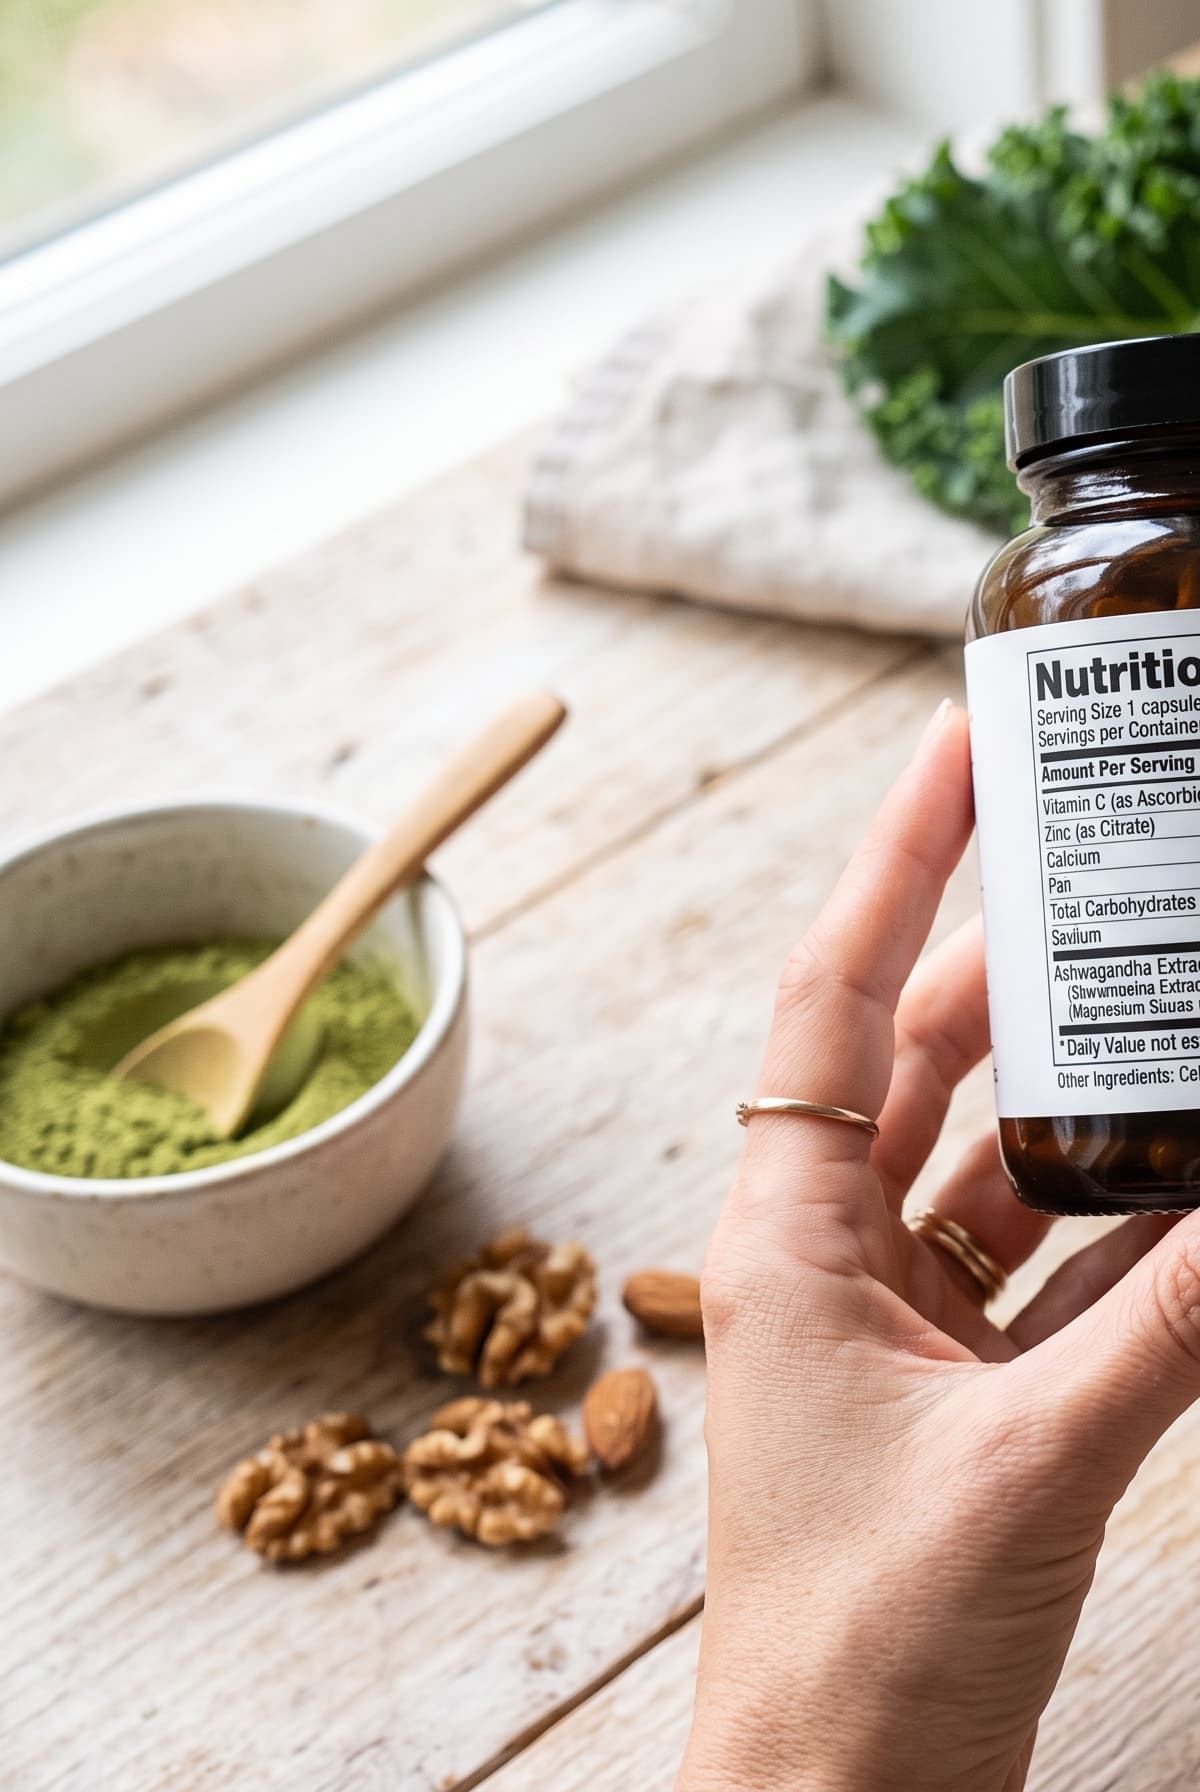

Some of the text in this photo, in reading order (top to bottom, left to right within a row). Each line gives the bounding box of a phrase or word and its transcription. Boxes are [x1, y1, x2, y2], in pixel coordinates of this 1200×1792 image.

[1037, 706, 1086, 726] Serving
[1091, 701, 1122, 720] Size
[1127, 700, 1134, 716] 1
[1038, 727, 1095, 747] Servings
[1100, 725, 1123, 744] per
[1041, 762, 1094, 783] Amount
[1099, 759, 1125, 776] Per
[1130, 755, 1195, 775] Serving
[1043, 795, 1090, 815] Vitamin
[1096, 794, 1105, 810] C
[1111, 793, 1133, 813] (as
[1044, 824, 1070, 842] Zinc
[1076, 822, 1096, 843] (as
[1100, 817, 1155, 839] Citrate)
[1047, 850, 1100, 868] Calcium
[1050, 901, 1081, 920] Total
[1085, 894, 1196, 917] Carbohydrates
[1054, 960, 1151, 983] Ashwagandha
[1069, 1002, 1145, 1020] (Magnesium
[1104, 1036, 1145, 1054] Value
[1151, 1034, 1176, 1051] not
[1058, 1071, 1089, 1088] Other
[1093, 1066, 1174, 1090] Ingredients:
